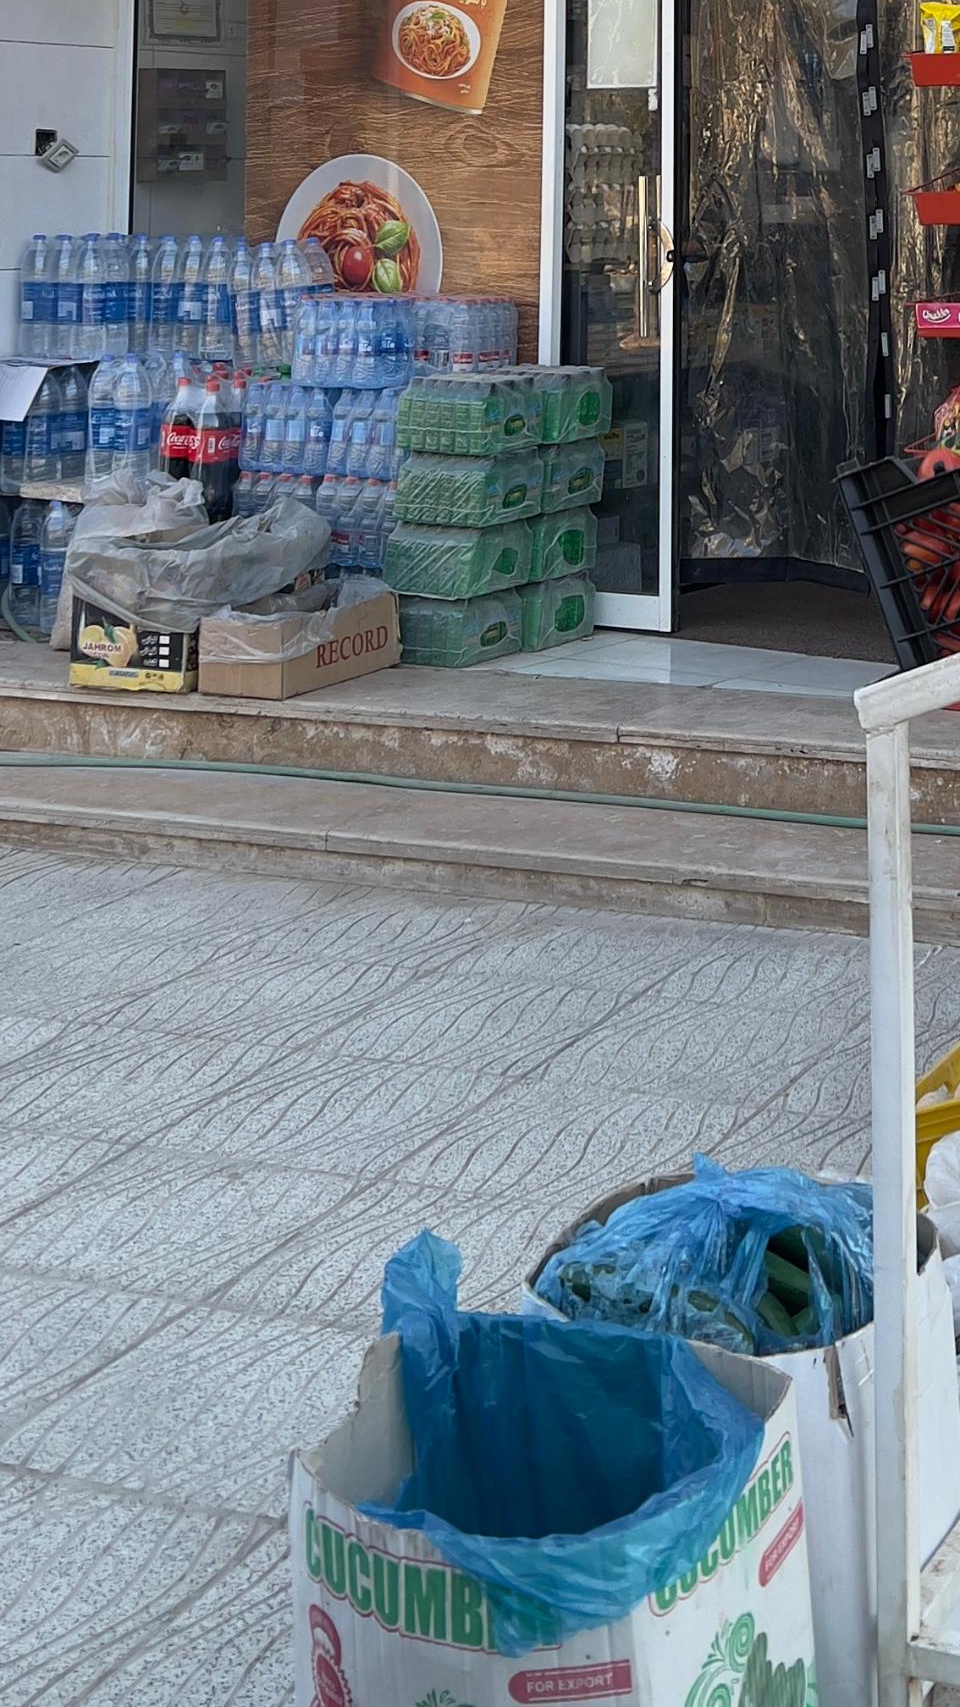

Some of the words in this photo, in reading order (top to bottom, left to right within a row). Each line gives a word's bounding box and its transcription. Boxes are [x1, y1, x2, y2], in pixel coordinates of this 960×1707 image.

[83, 642, 122, 653] JAHROM
[316, 625, 389, 669] RECORD
[527, 1681, 554, 1694] FOR
[558, 1673, 613, 1692] EXPORT
